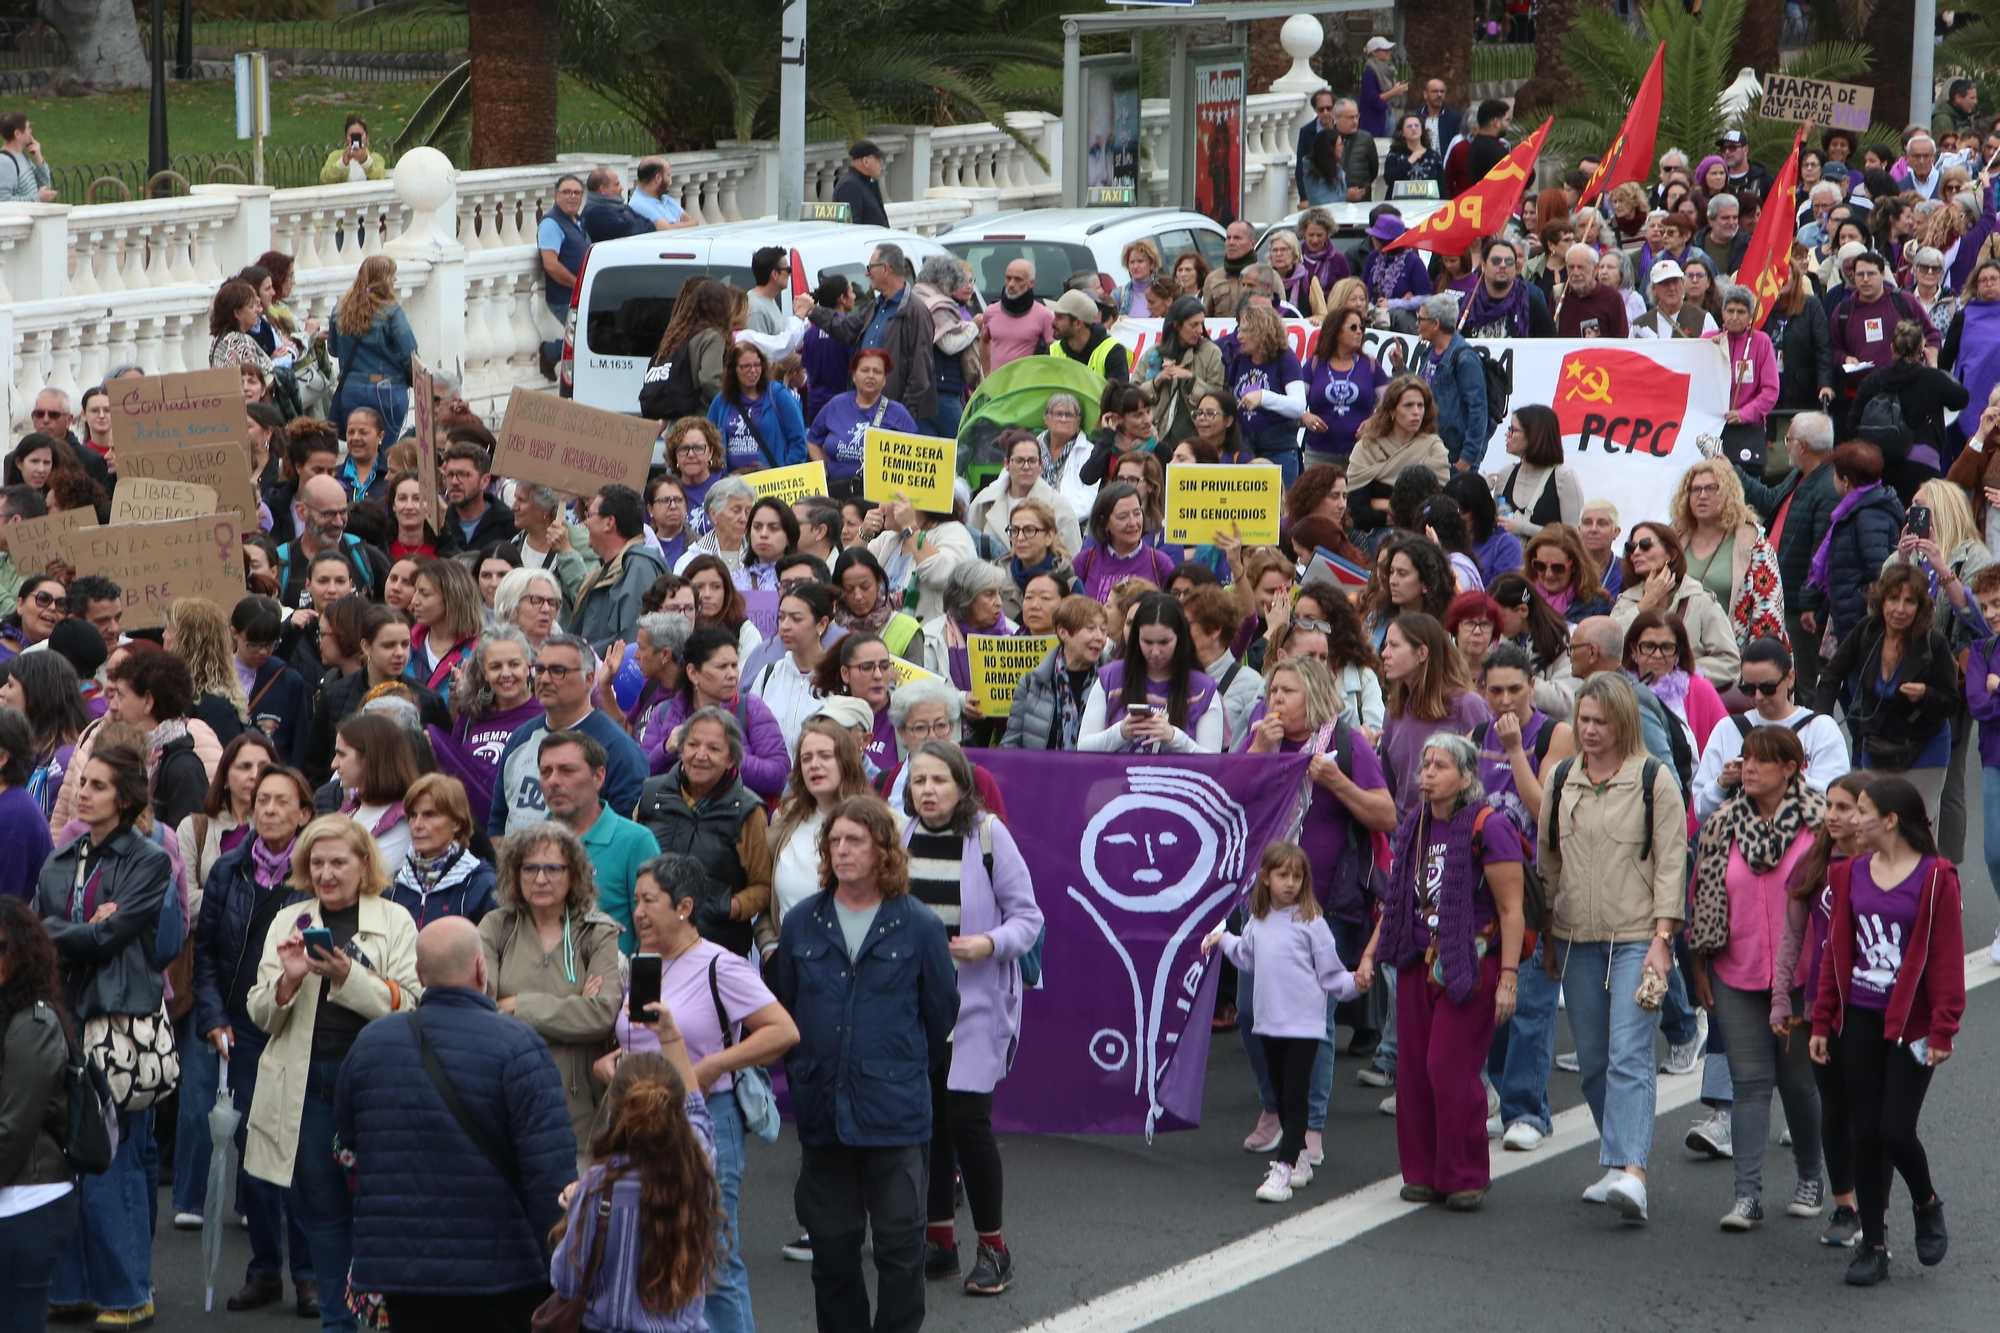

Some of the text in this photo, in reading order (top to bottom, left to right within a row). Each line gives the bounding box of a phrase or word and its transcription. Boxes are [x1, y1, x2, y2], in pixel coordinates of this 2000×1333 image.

[1196, 70, 1241, 104] Mahou
[1767, 76, 1857, 105] HARTA DE
[1765, 95, 1834, 113] AVISAR DE
[1761, 105, 1785, 119] QUE
[1834, 103, 1869, 131] VIVA
[1100, 190, 1122, 203] TAXI
[1407, 183, 1427, 195] TAXI
[814, 205, 837, 218] TAXI
[644, 362, 673, 384] VANS
[122, 385, 223, 416] Comadreo
[129, 419, 181, 442] Juntas
[517, 399, 650, 449] SIN RESPETO
[1577, 413, 1679, 457] PCPC
[508, 434, 525, 451] NO
[529, 438, 556, 460] HAY
[879, 440, 943, 461] LA PAZ SERÁ
[126, 450, 226, 478] NO QUIERO
[882, 455, 937, 474] FEMINISTA
[882, 470, 936, 489] O NO SERÁ
[1179, 480, 1268, 492] SIN PRIVILEGIOS
[133, 482, 195, 503] LIBRES
[1179, 508, 1267, 520] SIN GENOCIDIOS
[15, 515, 80, 544] ELLA YA
[1173, 529, 1187, 539] 8M
[36, 540, 51, 553] NO
[91, 528, 213, 558] EN LA CALLE
[170, 555, 204, 569] SER
[192, 578, 213, 593] NO
[978, 638, 1047, 653] LAS MUJERES
[984, 655, 1040, 669] NO SOMOS
[471, 730, 512, 744] SIEMP
